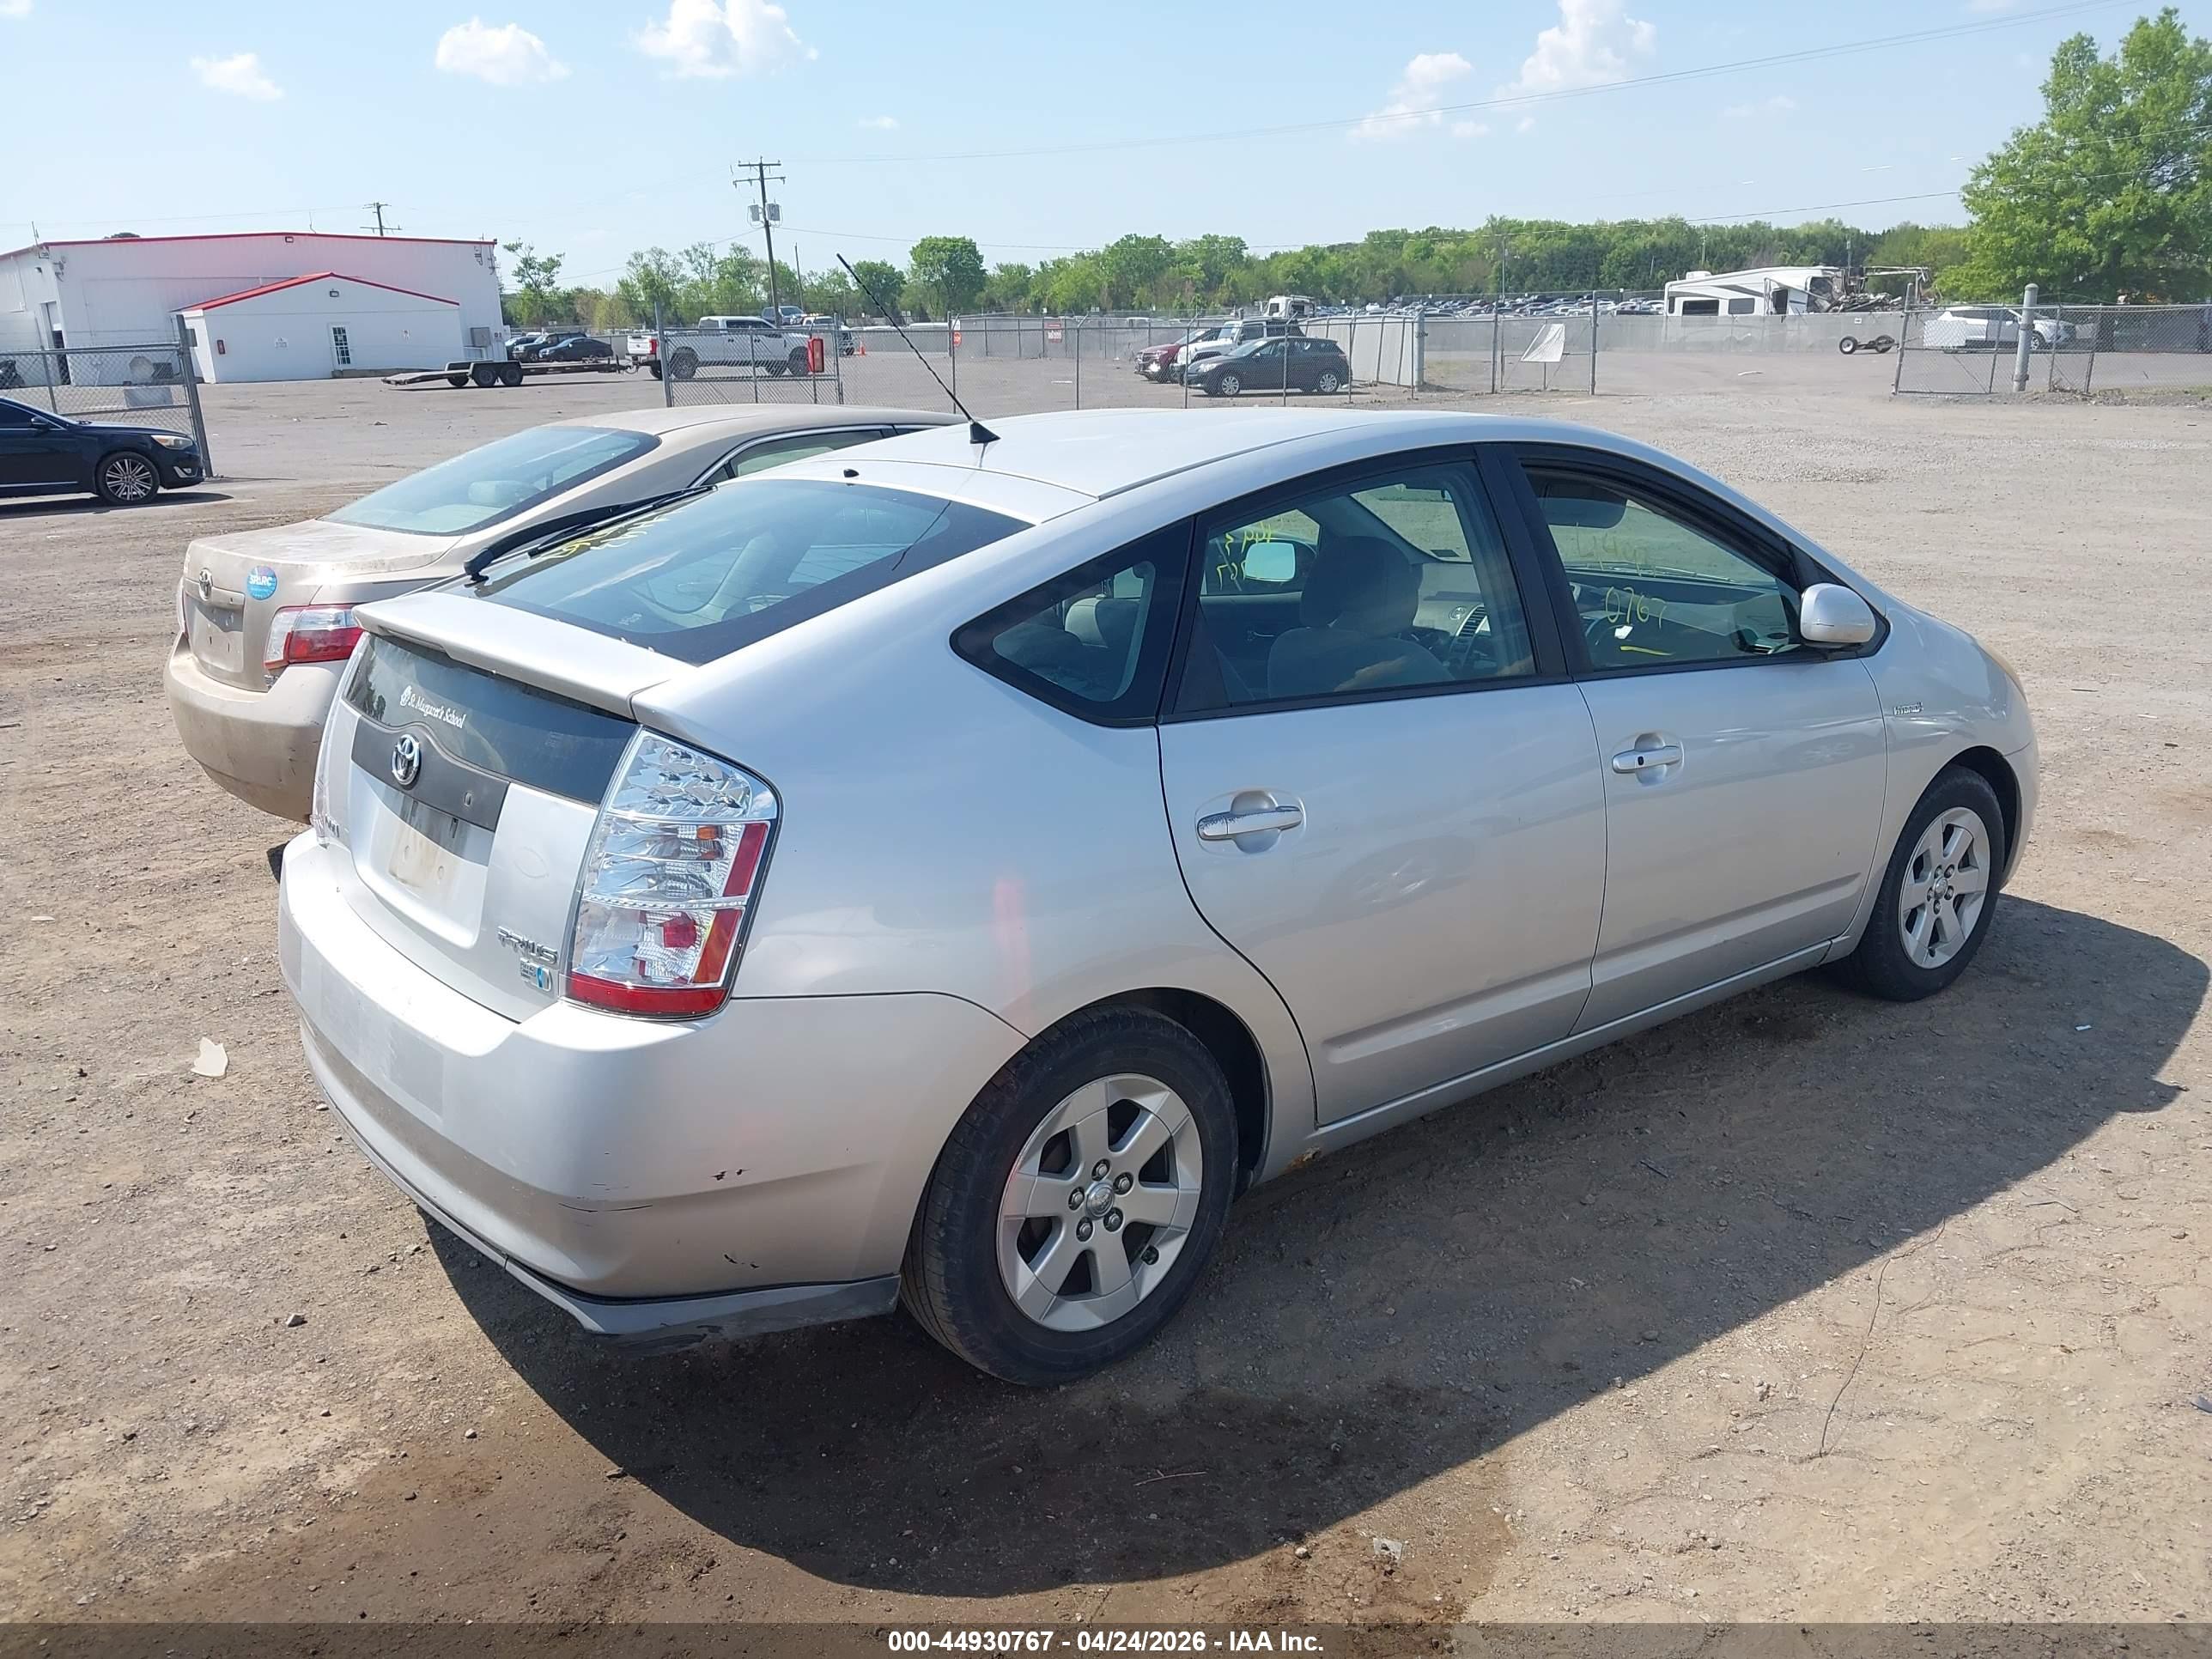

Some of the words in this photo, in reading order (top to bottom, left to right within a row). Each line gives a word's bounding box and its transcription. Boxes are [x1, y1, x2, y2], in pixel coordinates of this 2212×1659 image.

[1605, 586, 1668, 629] 0767
[443, 708, 466, 728] School
[497, 926, 558, 964] PRIUS
